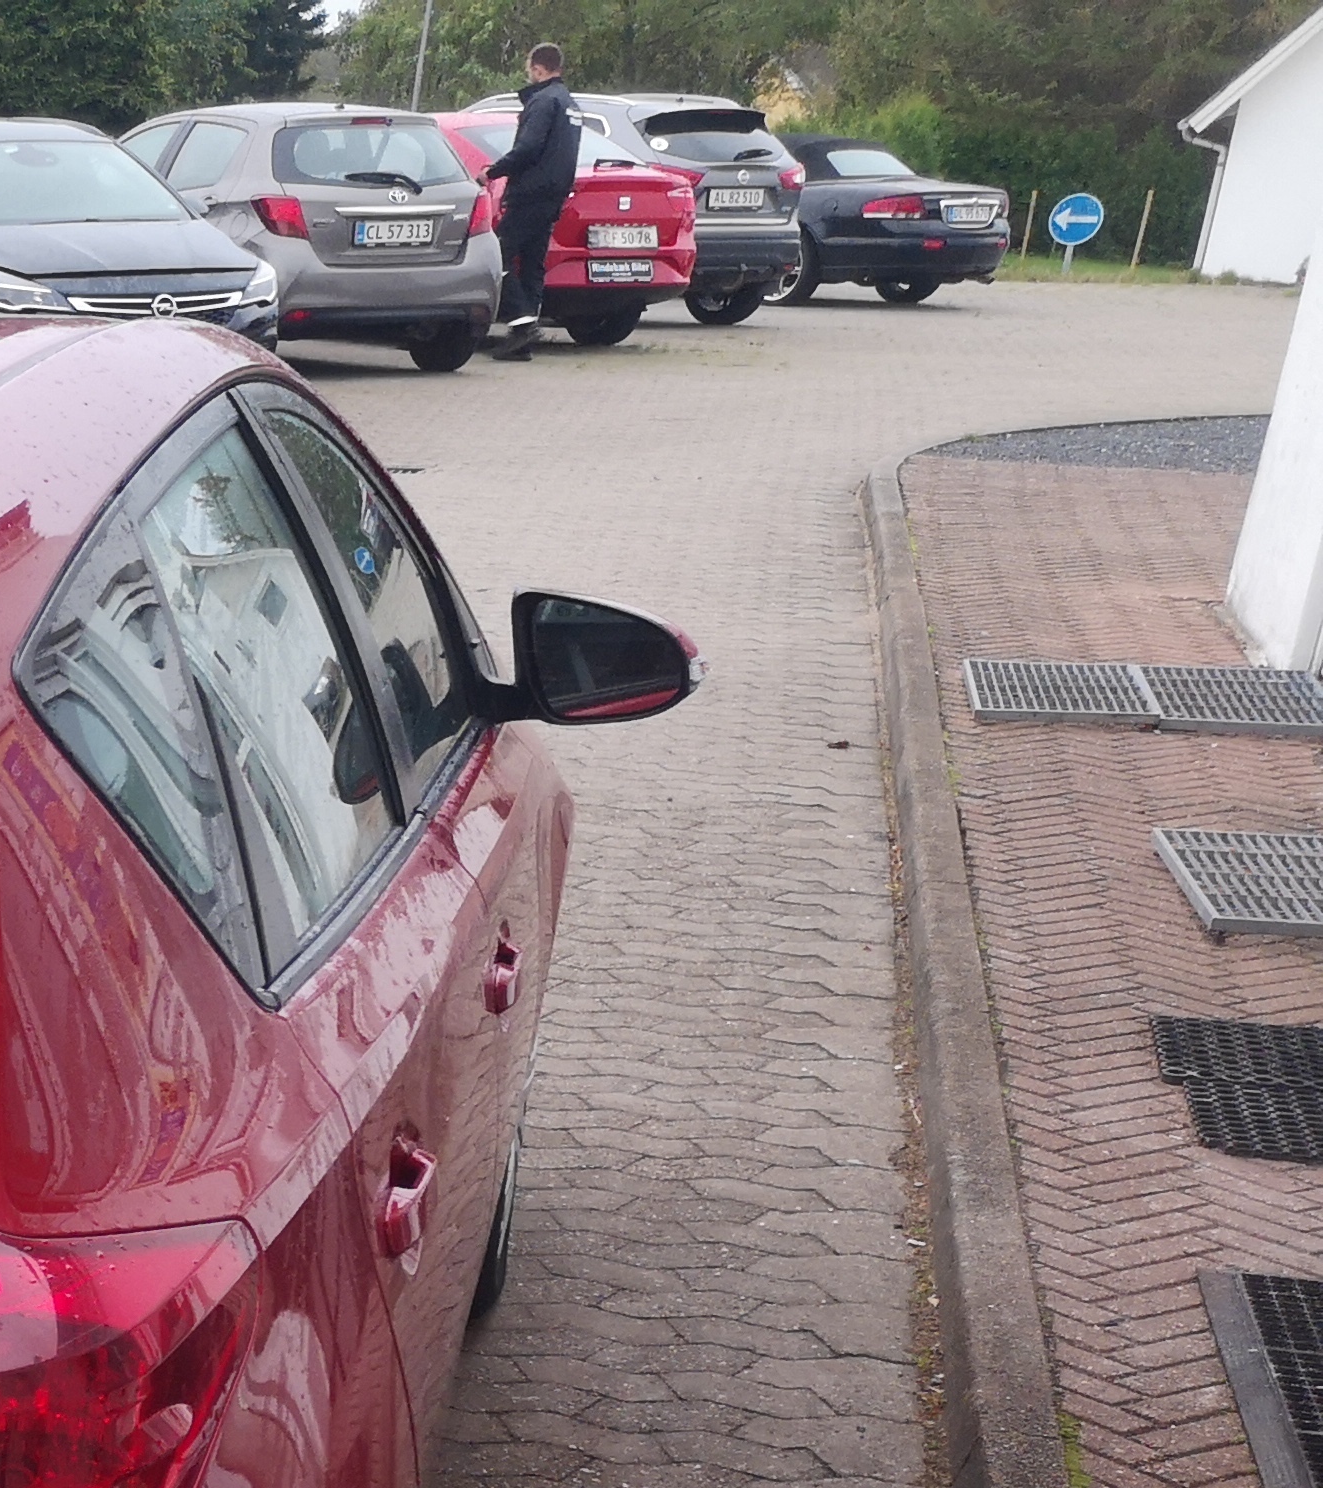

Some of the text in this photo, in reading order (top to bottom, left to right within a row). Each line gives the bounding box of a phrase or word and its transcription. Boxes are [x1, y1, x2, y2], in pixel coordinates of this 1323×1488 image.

[713, 191, 726, 204] AL
[366, 223, 430, 240] CL 57 313
